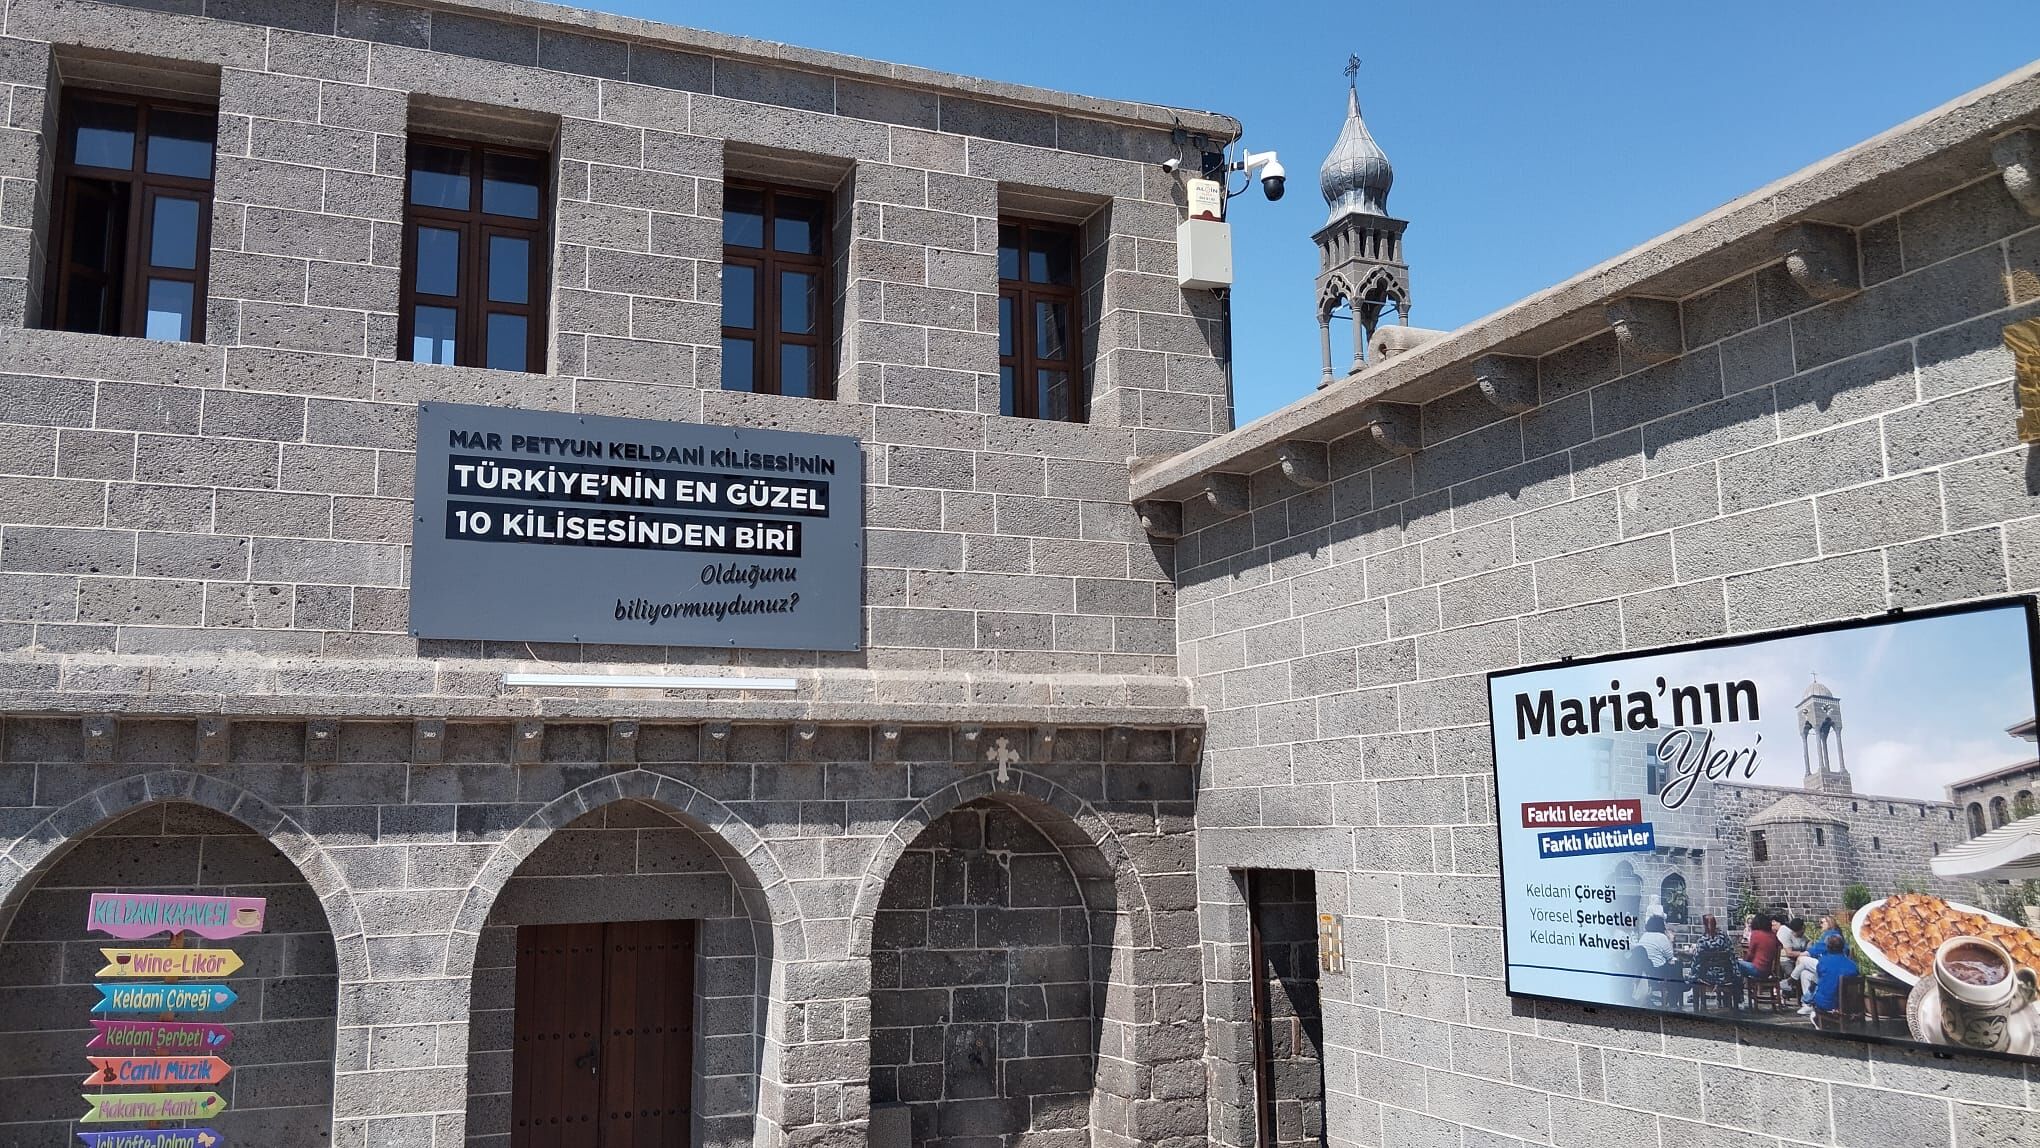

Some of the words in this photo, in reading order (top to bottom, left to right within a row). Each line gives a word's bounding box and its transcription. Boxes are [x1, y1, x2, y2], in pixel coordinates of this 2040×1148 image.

[450, 429, 502, 451] MAR
[511, 434, 602, 458] PETYUN
[609, 441, 704, 466] KELDANİ
[676, 479, 717, 504] EN
[726, 479, 826, 511] GÜZEL
[455, 510, 492, 535] 10
[502, 508, 726, 547] KİLİSESİNDEN
[735, 522, 794, 551] BİRİ
[701, 563, 797, 589] Olduğunu
[614, 593, 800, 625] biliyormuydunuz?
[1514, 675, 1760, 741] Maria'nın
[1656, 728, 1763, 810] Yeri
[1527, 806, 1567, 824] Farklı
[1569, 805, 1634, 823] lezzetler
[1542, 836, 1582, 854] Farklı
[1584, 831, 1650, 851] kültürler
[1526, 883, 1571, 899] Keldani
[1574, 884, 1617, 904] Çöreği
[1529, 906, 1574, 923] Yöresel
[1576, 908, 1638, 928] Şerbetler
[1529, 929, 1575, 946] Keldani
[1578, 931, 1631, 951] Kahvesi
[133, 953, 226, 974] Wine-Likör
[112, 988, 164, 1009] Keldani
[167, 988, 212, 1011] Çöreği
[106, 1025, 156, 1046] Keldani
[119, 1060, 161, 1081] Canlı
